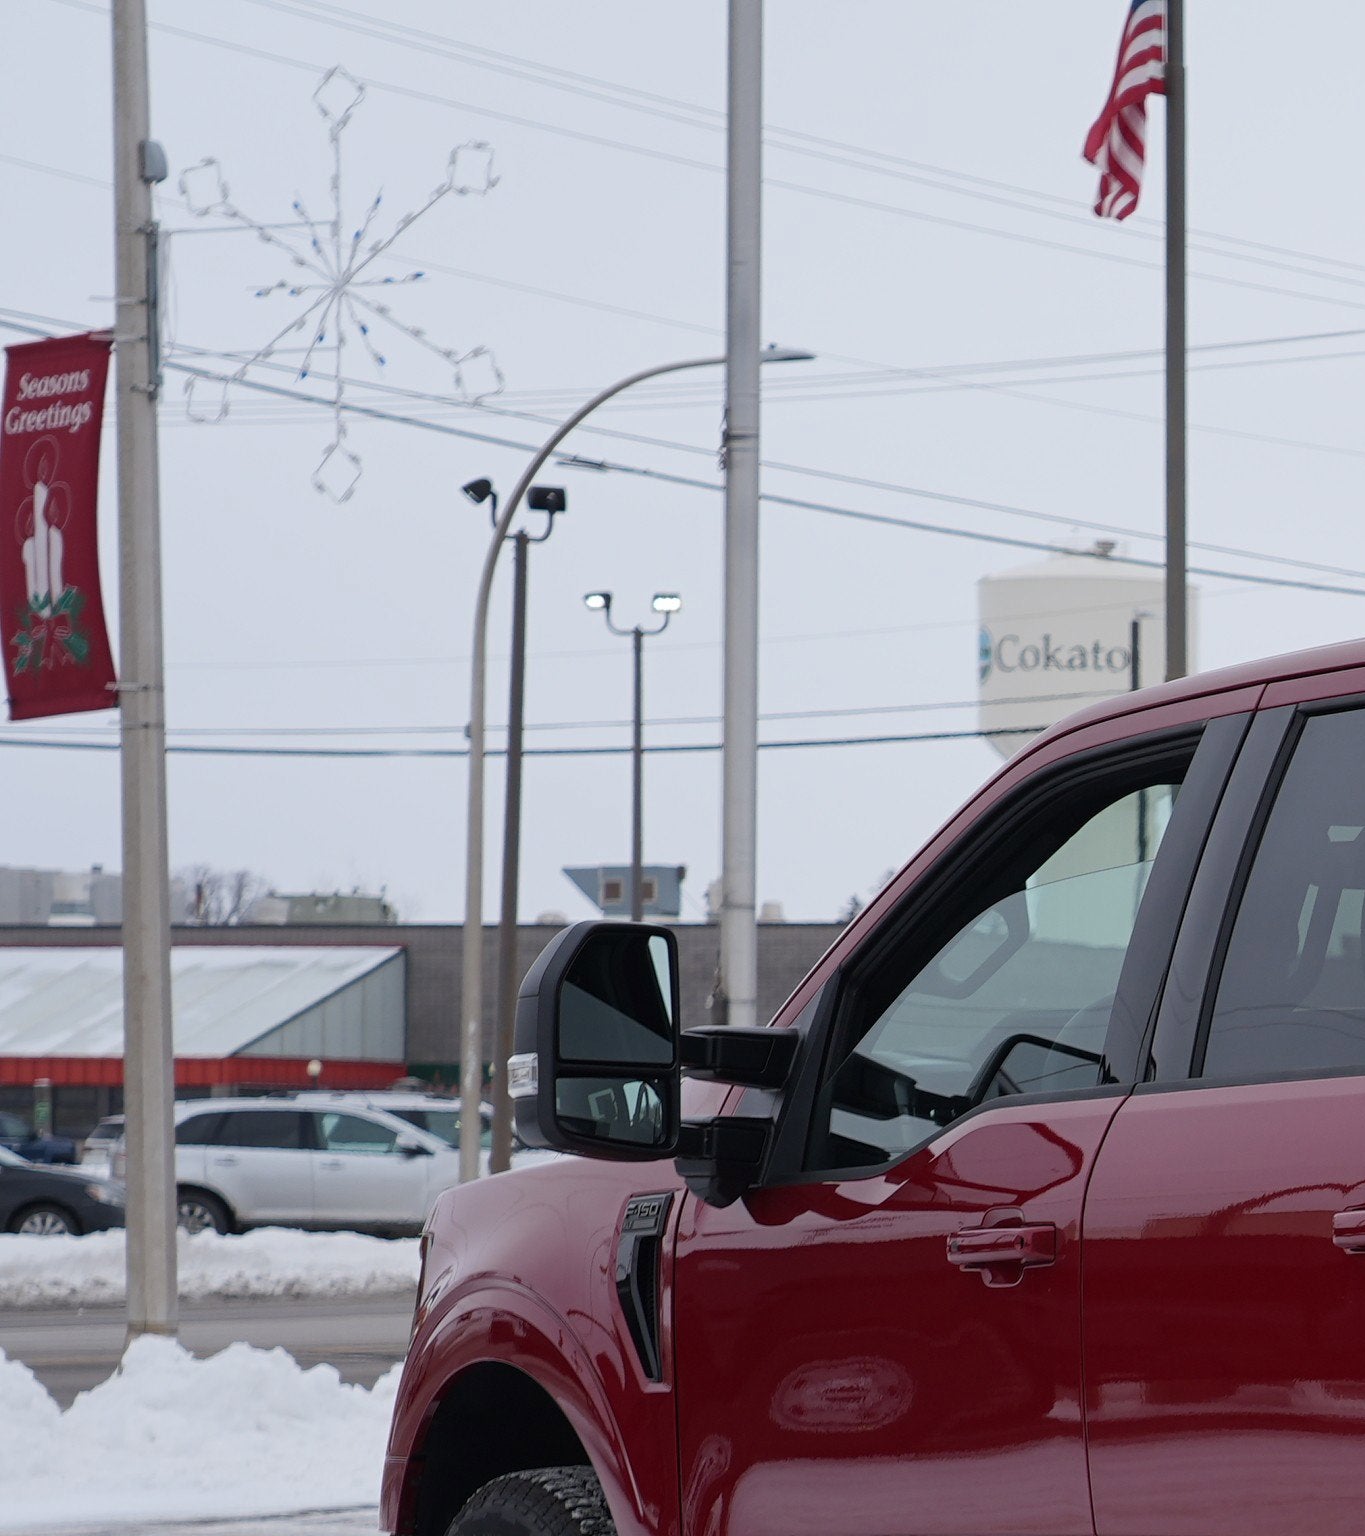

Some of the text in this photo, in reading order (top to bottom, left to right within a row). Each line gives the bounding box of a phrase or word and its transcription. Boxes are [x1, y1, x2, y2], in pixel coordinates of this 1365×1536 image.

[17, 369, 90, 401] Seasons
[5, 400, 93, 434] Greetings
[994, 633, 1131, 673] Cokato
